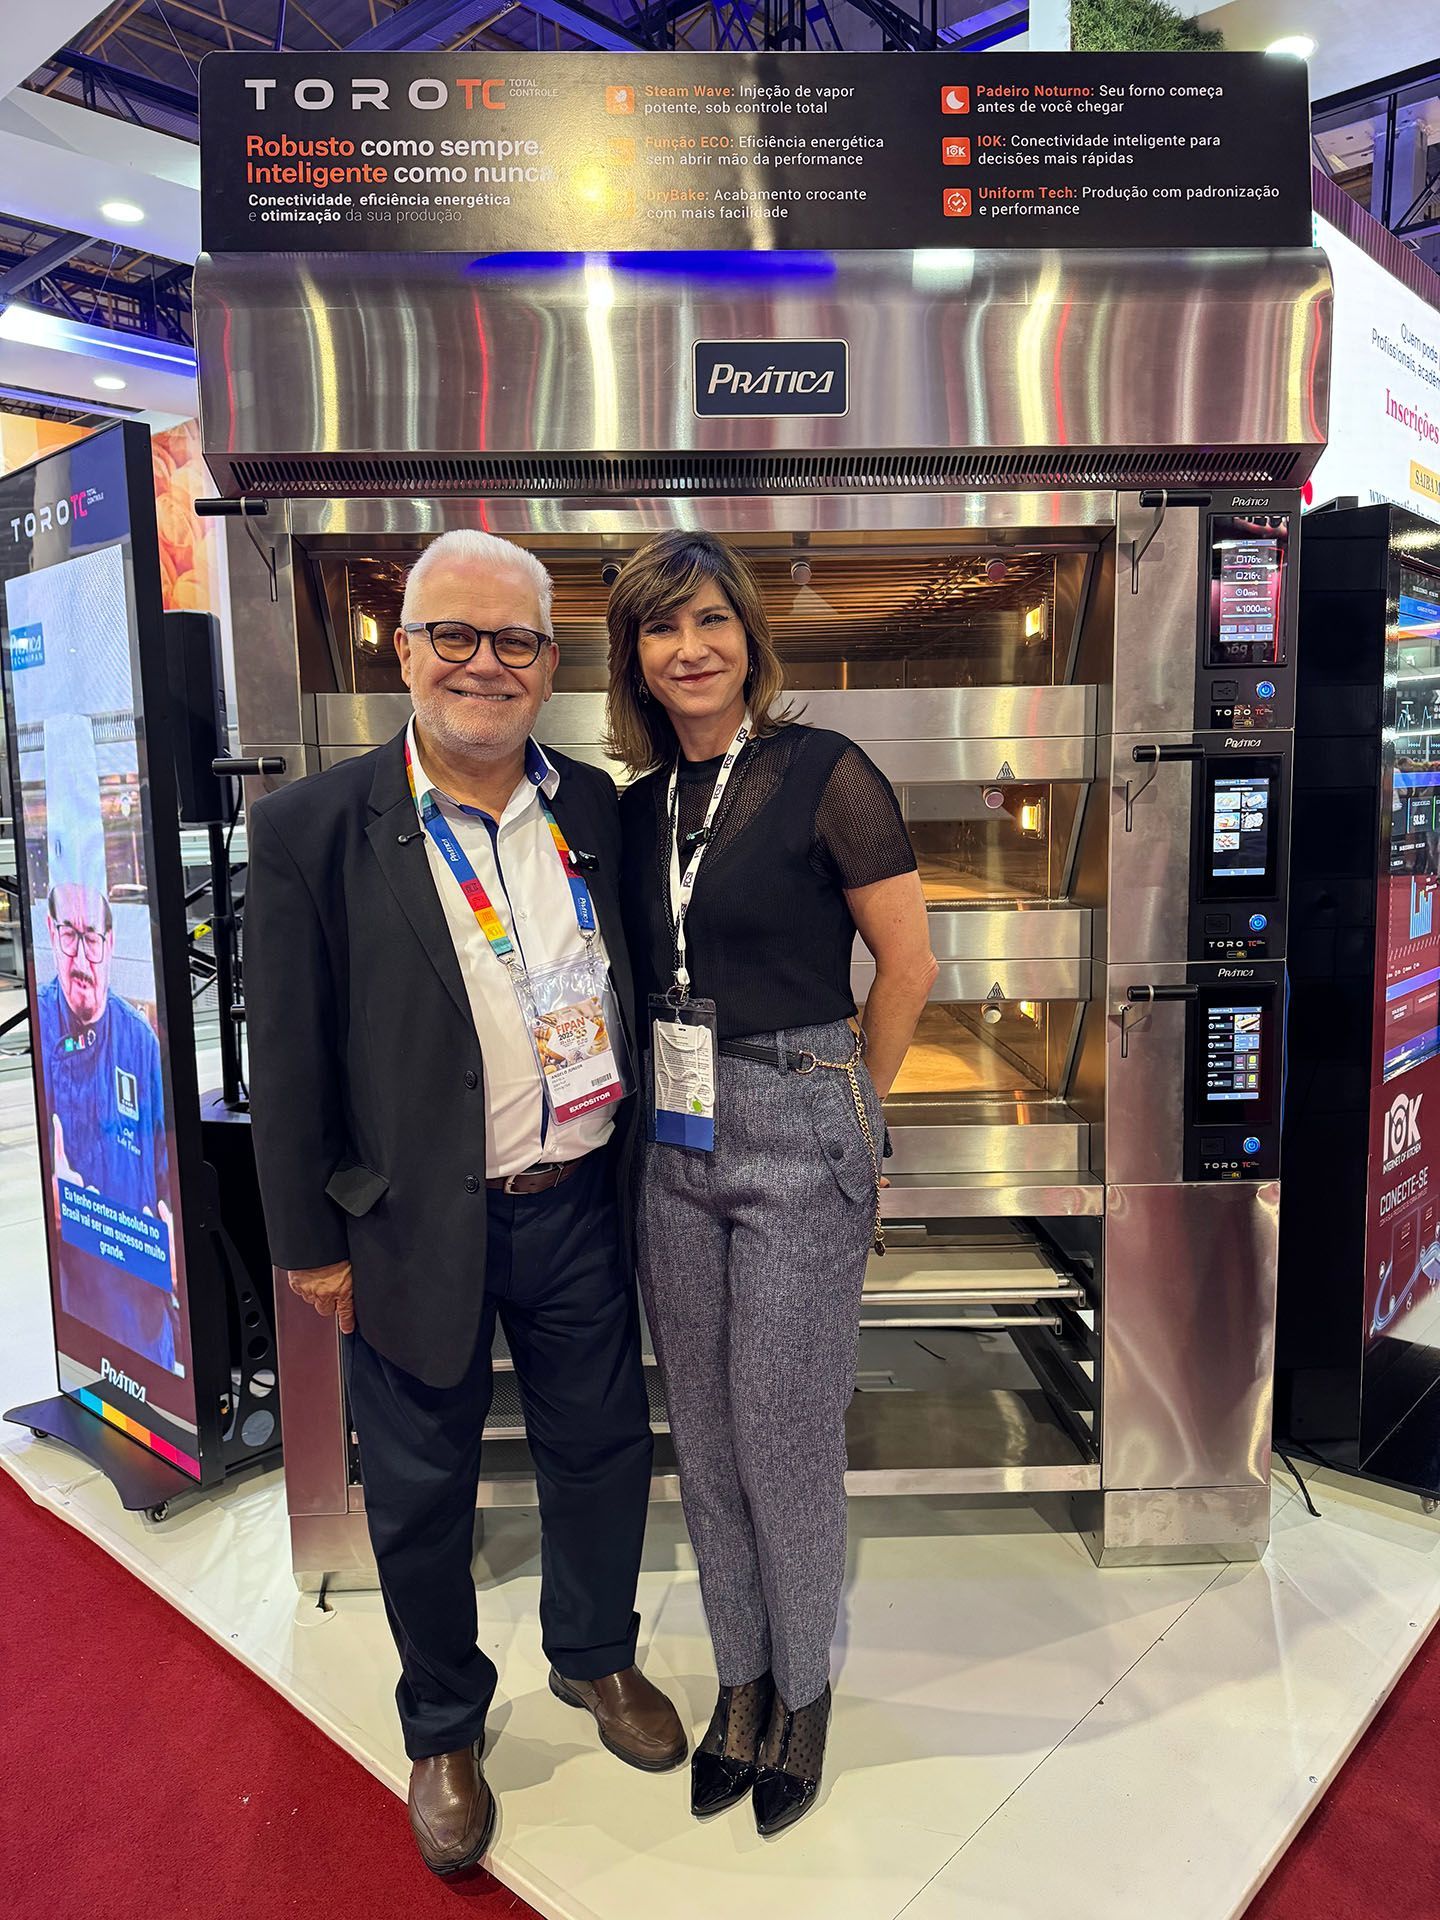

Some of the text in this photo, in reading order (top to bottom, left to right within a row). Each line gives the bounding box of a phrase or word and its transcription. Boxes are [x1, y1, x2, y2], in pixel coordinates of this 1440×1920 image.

[508, 78, 538, 86] TOTAL
[244, 78, 506, 110] TORO TC
[508, 88, 559, 97] CONTROLE
[644, 85, 855, 100] Steam Wave: Injeção de vapor
[976, 85, 1224, 98] Padeiro Noturno: Seu forno começa
[644, 102, 828, 116] potente, sob controle total
[976, 100, 1124, 115] antes de você chegar
[246, 135, 355, 158] Robusto
[361, 139, 434, 157] como
[645, 136, 884, 152] Função ECO: Eficiência energética
[977, 134, 1221, 150] IOK: Conectividade inteligente para
[646, 153, 864, 168] sem abrir mão da performance
[978, 152, 1134, 168] decisões mais rápidas
[246, 161, 388, 188] Inteligente
[394, 166, 468, 184] como
[714, 188, 802, 201] Acabamento
[806, 189, 867, 201] crocante
[978, 185, 1280, 200] Uniform Tech: Produção com padronização
[248, 193, 511, 209] Conectividade, eficiência energética
[248, 212, 256, 221] e
[260, 210, 341, 224] otimização
[345, 210, 362, 222] da
[366, 212, 392, 222] sua
[647, 206, 788, 219] com mais facilidade
[979, 204, 1080, 218] e performance
[1401, 323, 1438, 364] Quem pode
[1386, 388, 1440, 444] Inscrições
[10, 490, 88, 543] TORO TC
[556, 1016, 586, 1035] FIPAN
[558, 1031, 573, 1041] 2025
[569, 1091, 611, 1113] EXPOSITOR
[1380, 1166, 1429, 1217] CONECTE-SE
[64, 1186, 159, 1240] Eu tenho certeza absoluta no
[62, 1203, 166, 1262] Brasil vai ser um sucesso muito
